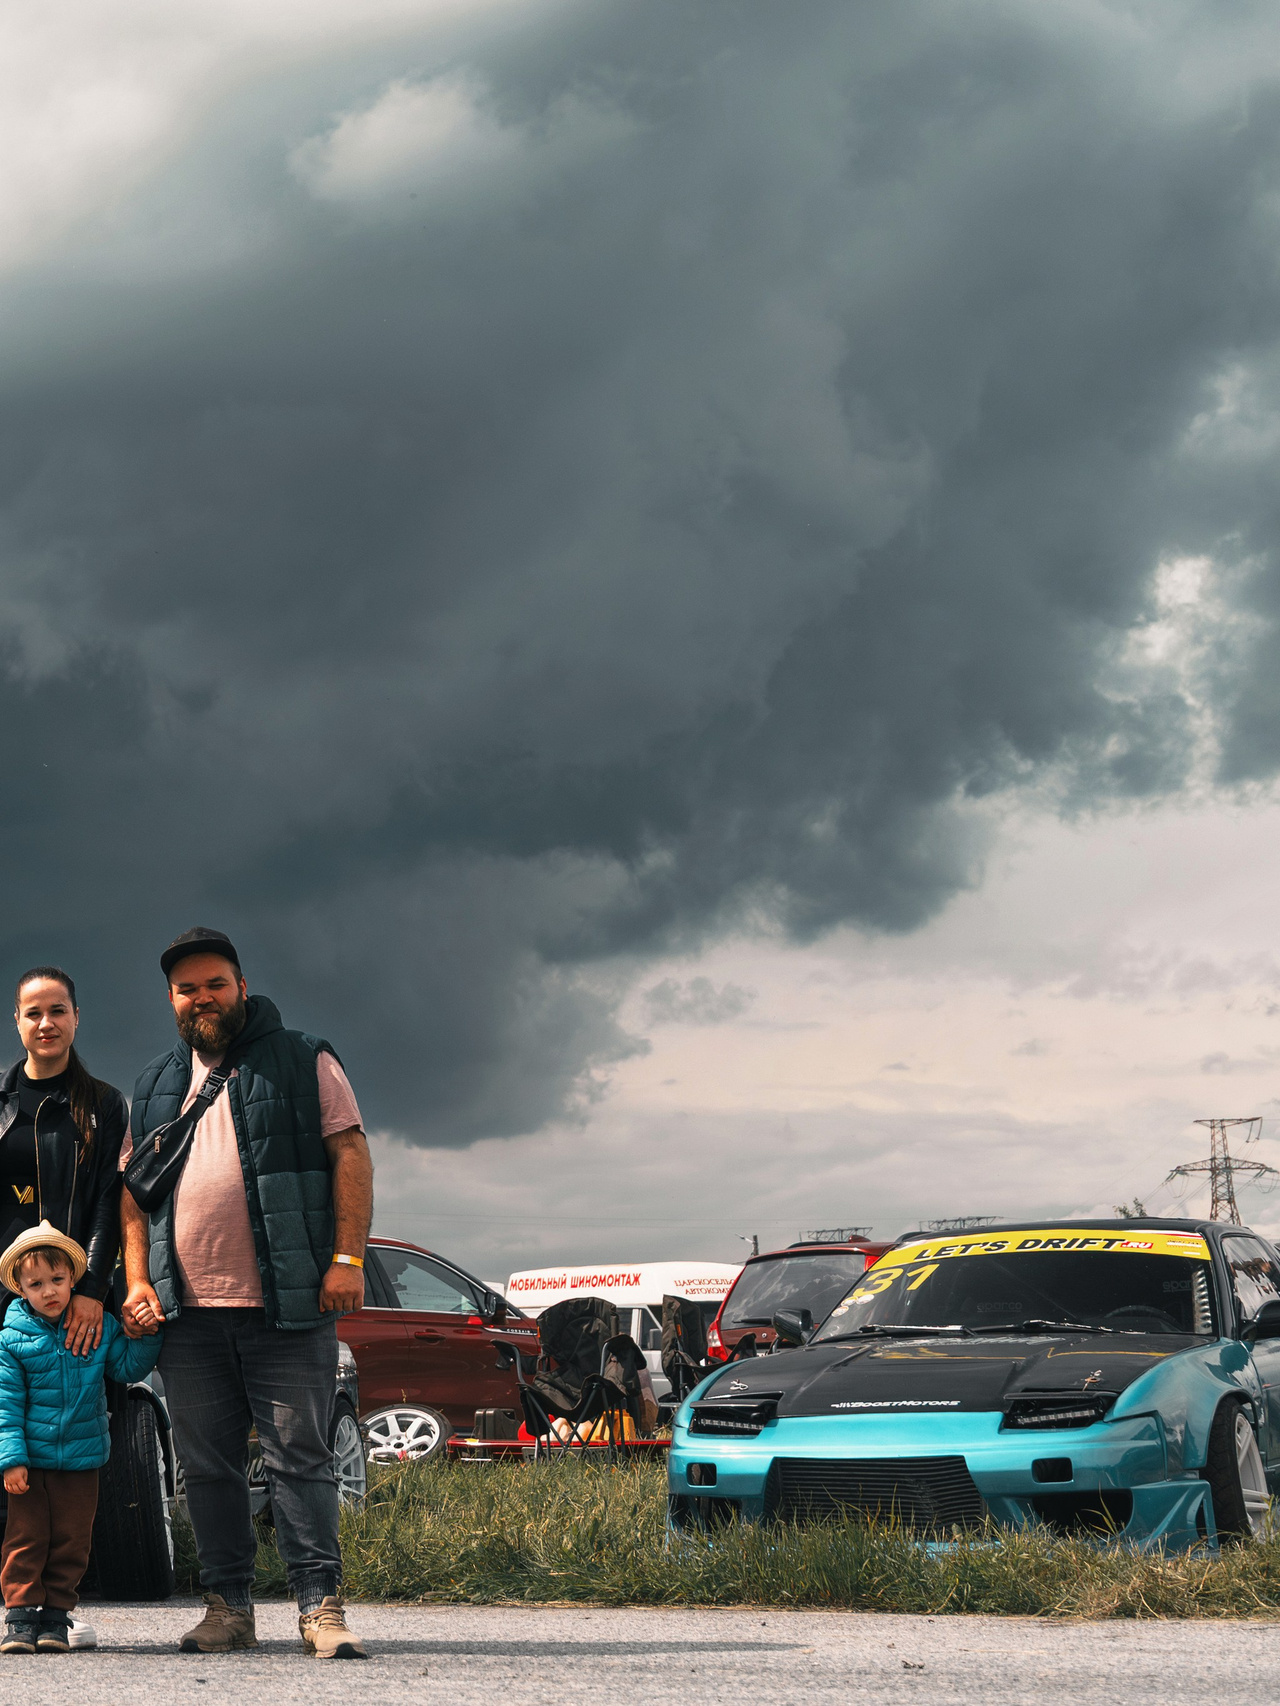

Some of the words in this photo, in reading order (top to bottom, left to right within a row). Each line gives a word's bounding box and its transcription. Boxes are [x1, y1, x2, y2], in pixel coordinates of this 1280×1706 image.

[914, 1240, 1011, 1260] LET'S
[509, 1273, 567, 1291] МОБИЛЬНЫЙ
[570, 1272, 642, 1289] ШИНОМОНТАЖ
[854, 1264, 939, 1298] 31
